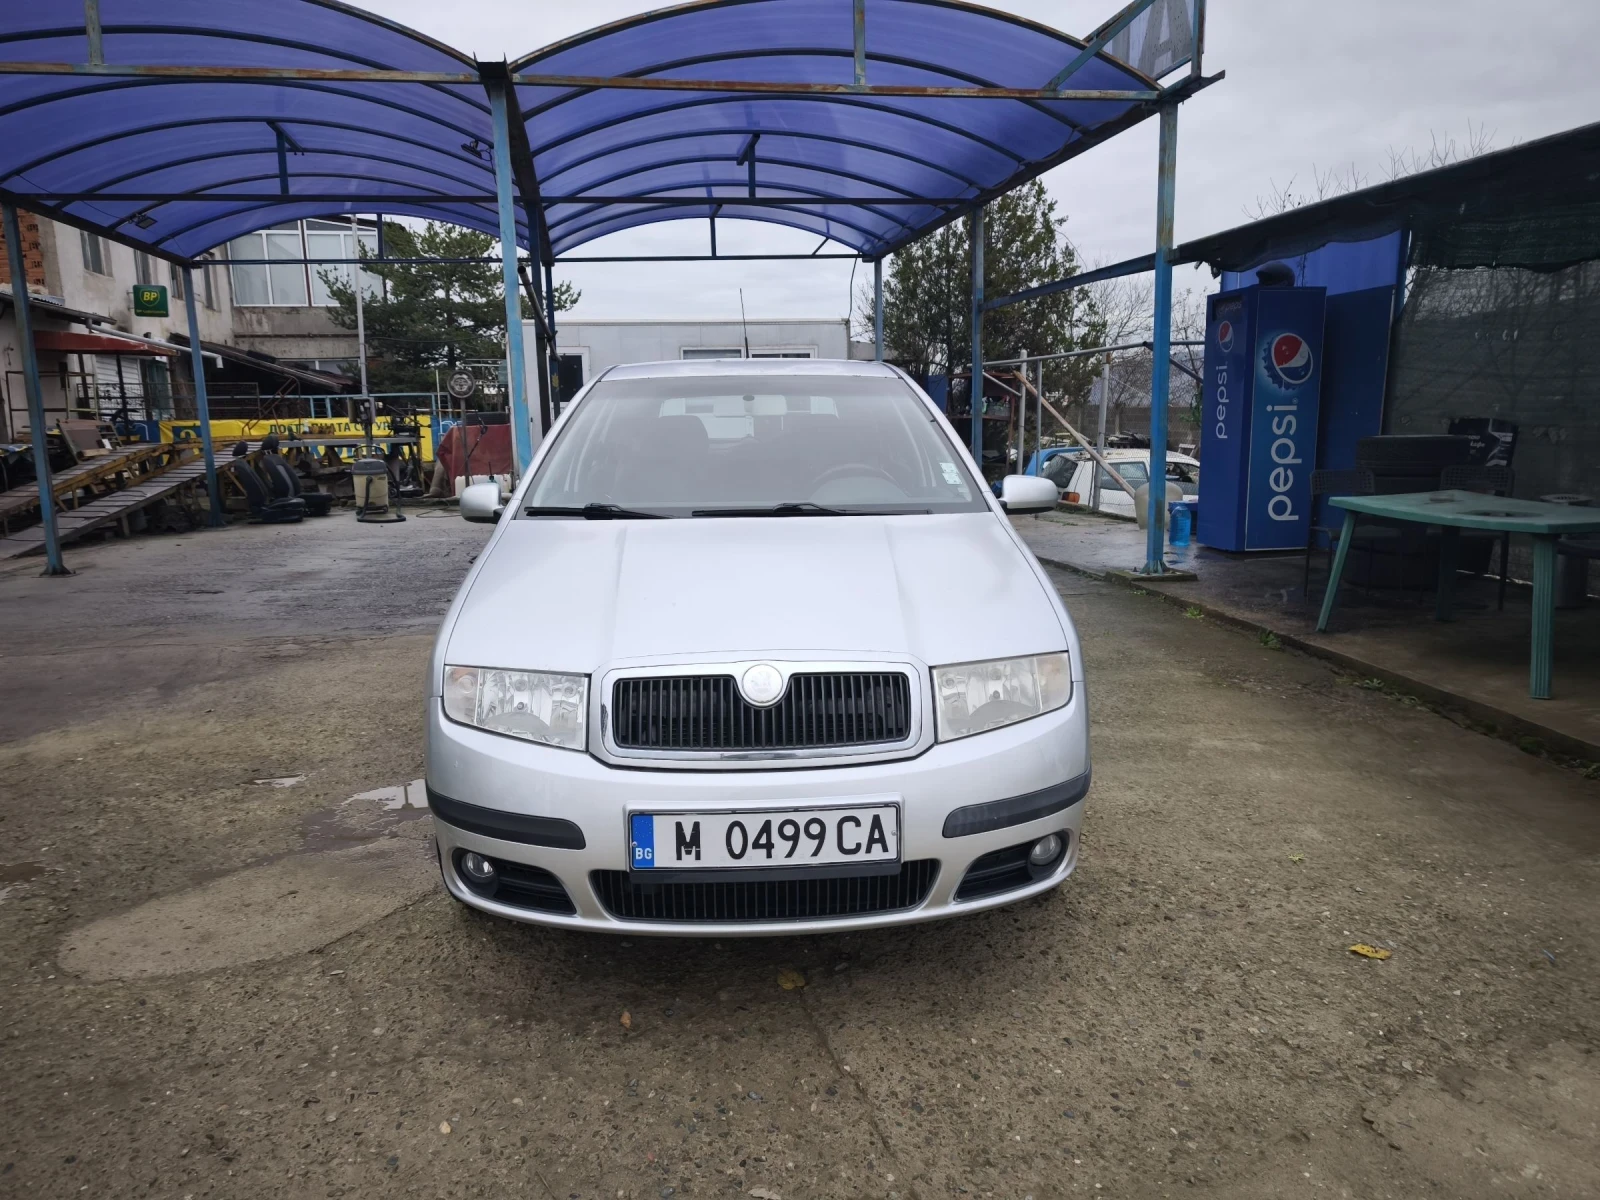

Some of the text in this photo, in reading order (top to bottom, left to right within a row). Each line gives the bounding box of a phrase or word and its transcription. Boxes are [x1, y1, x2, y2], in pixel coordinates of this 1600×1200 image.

[143, 291, 158, 301] BP
[1215, 365, 1229, 439] pepsi
[1266, 404, 1302, 521] pepsi
[635, 847, 653, 860] BG
[675, 821, 701, 861] M
